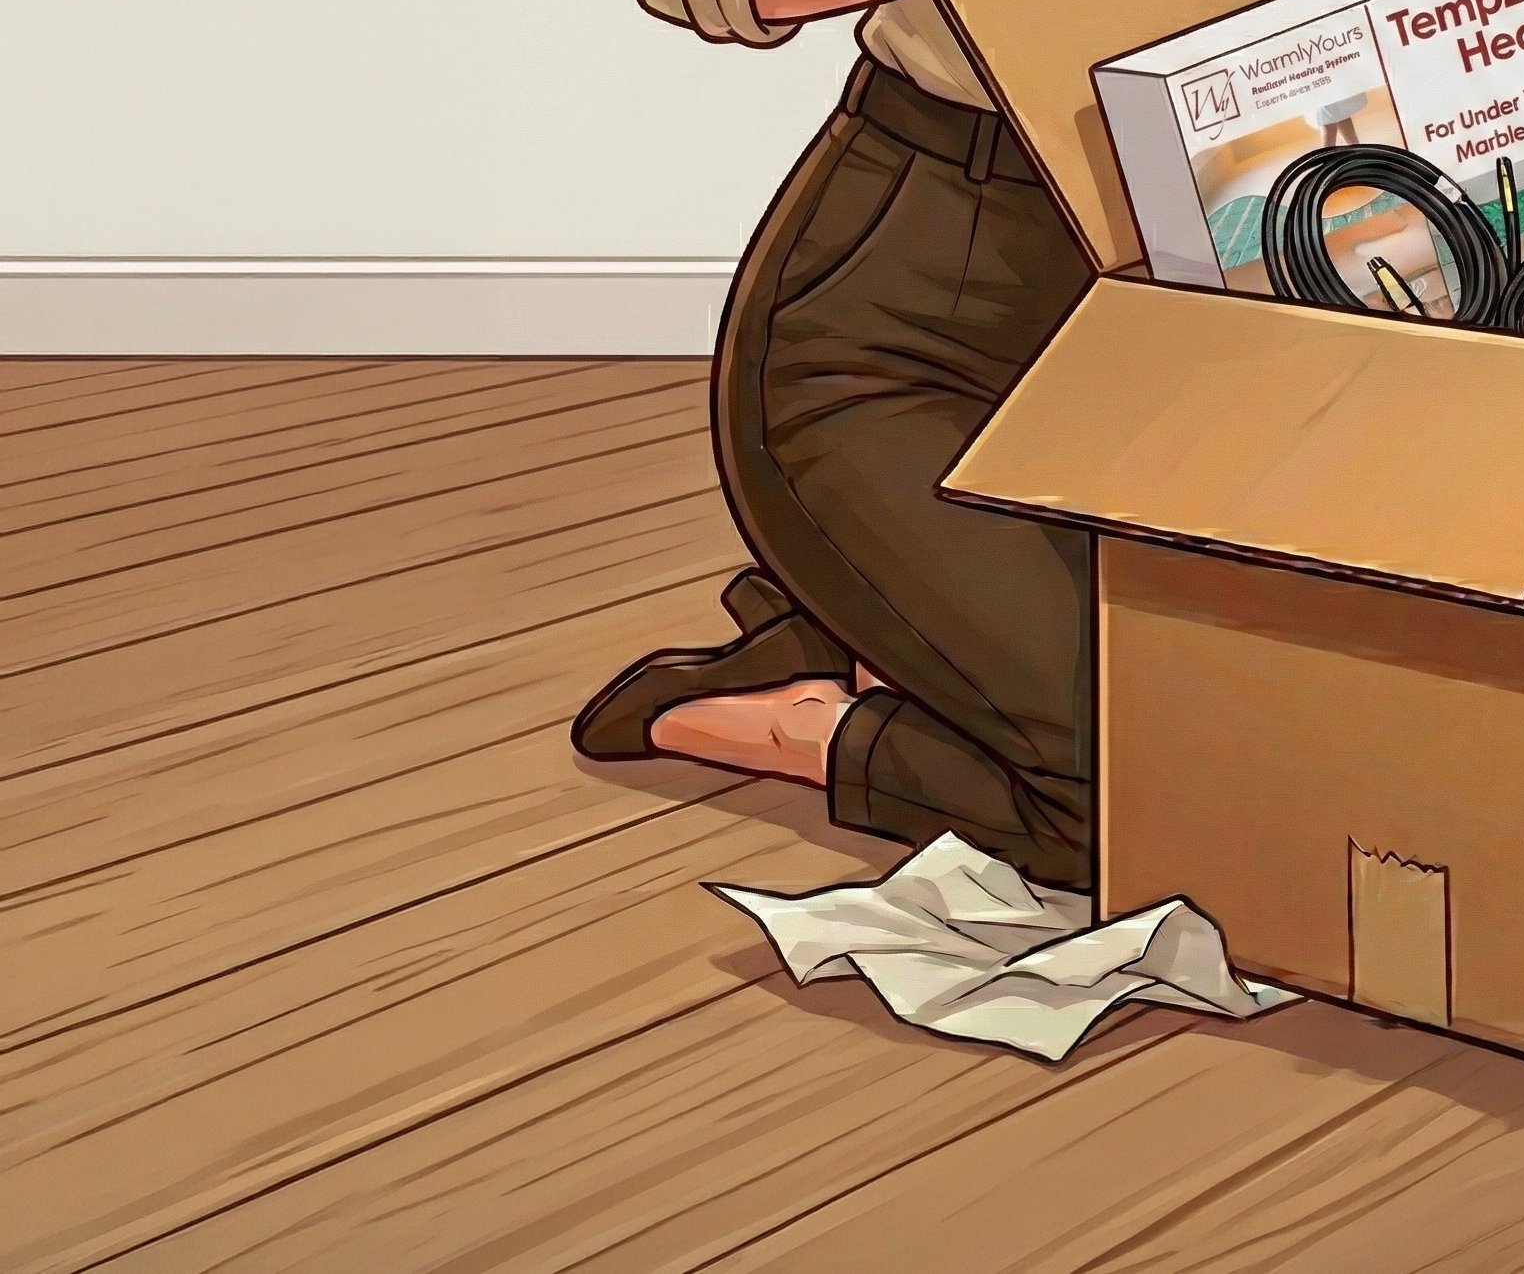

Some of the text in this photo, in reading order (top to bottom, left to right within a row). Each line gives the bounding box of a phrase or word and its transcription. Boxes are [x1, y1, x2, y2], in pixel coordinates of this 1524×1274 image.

[1239, 26, 1364, 81] WarmlyYours
[1424, 120, 1456, 142] For
[1459, 97, 1519, 131] Under
